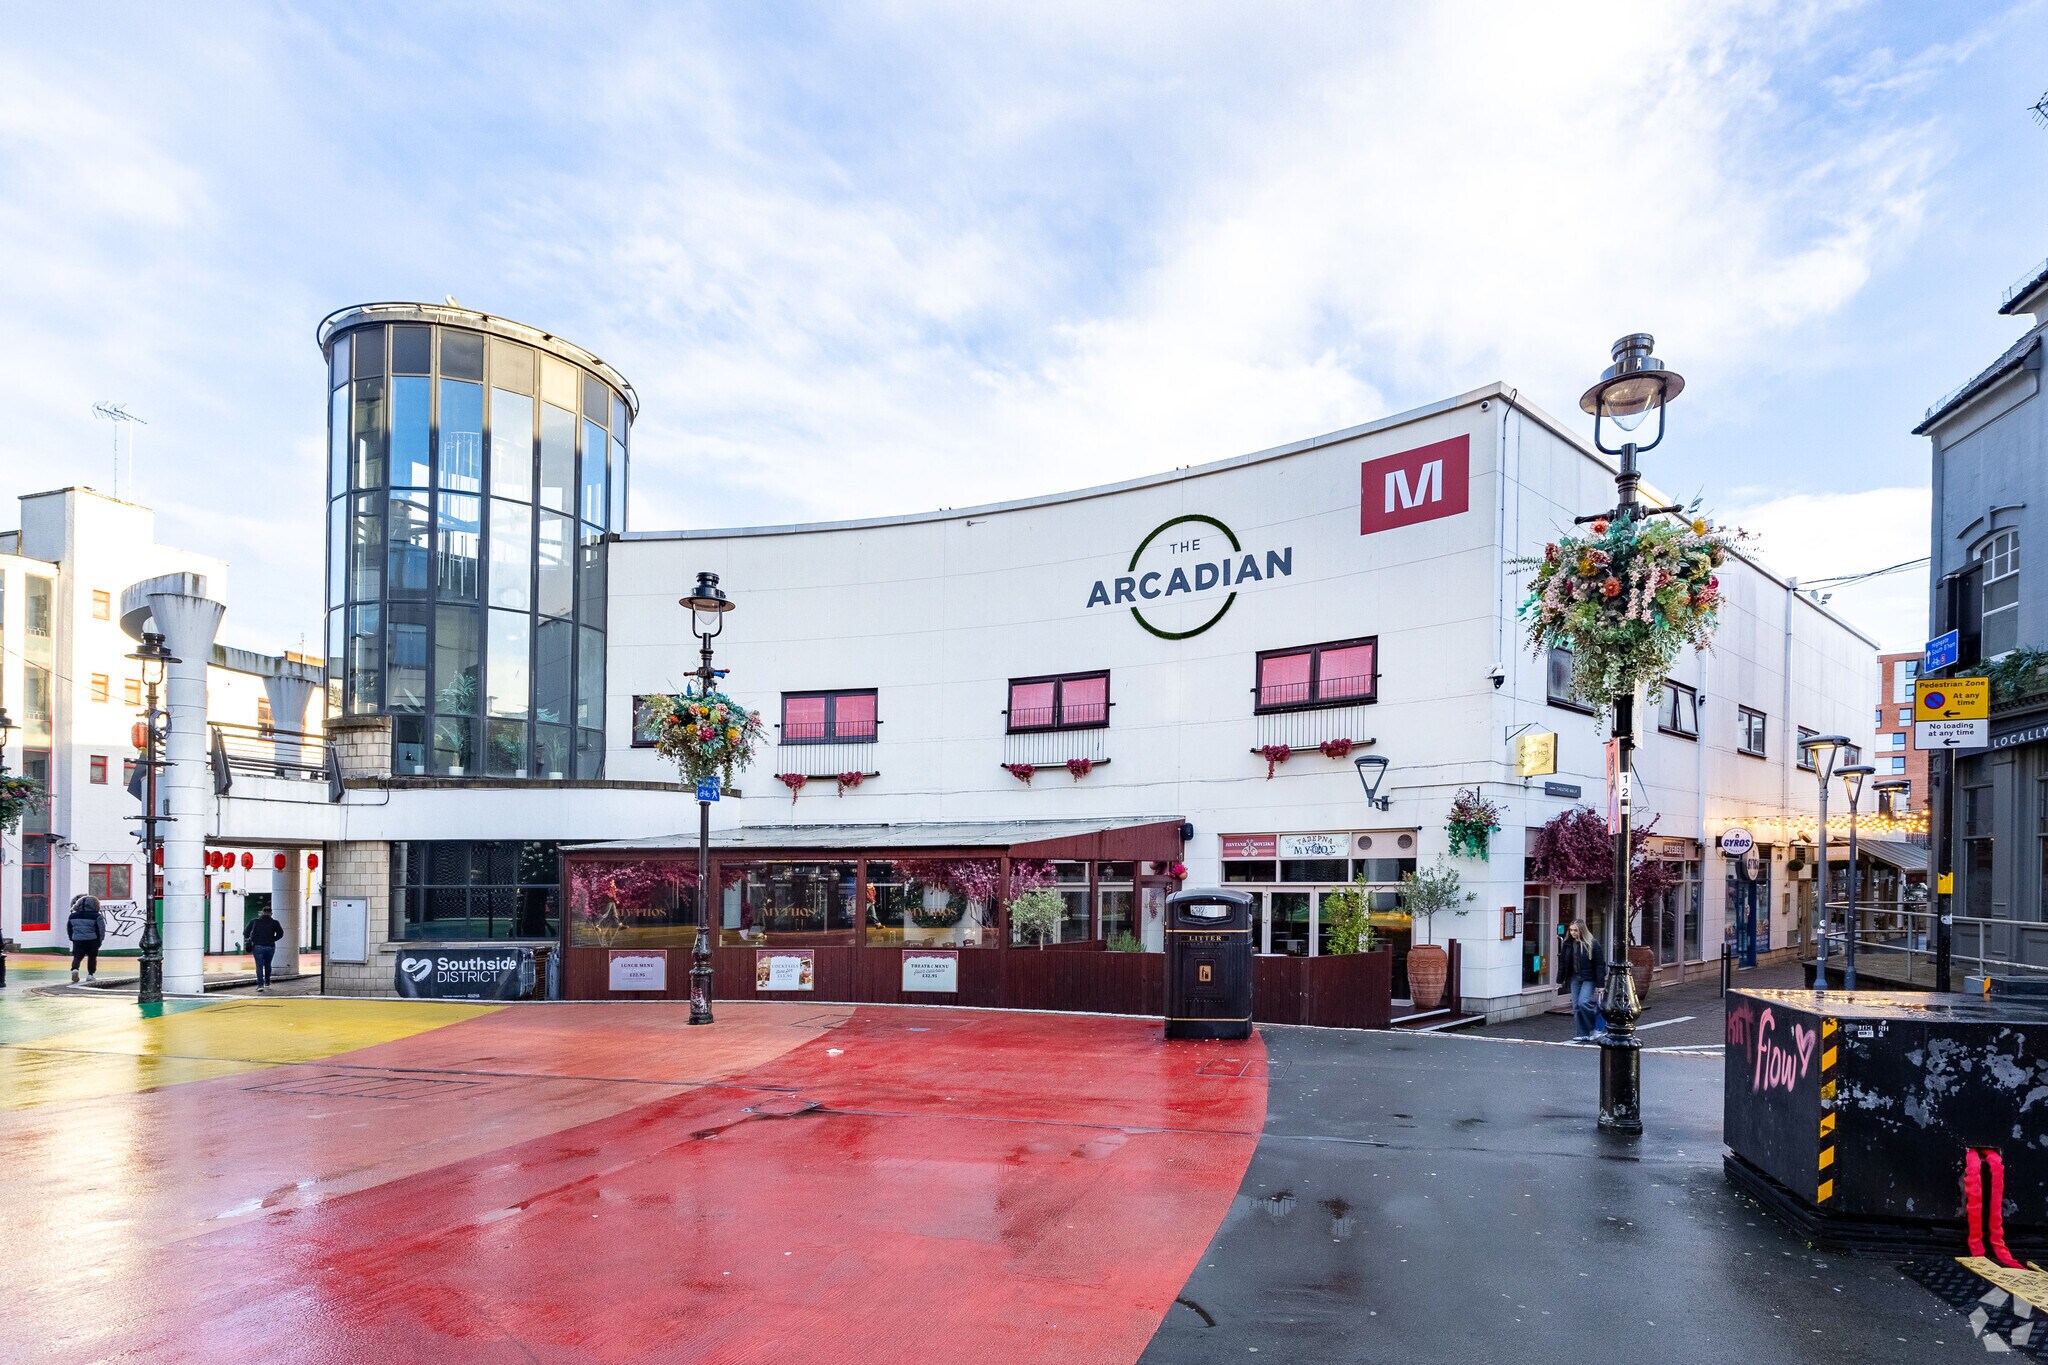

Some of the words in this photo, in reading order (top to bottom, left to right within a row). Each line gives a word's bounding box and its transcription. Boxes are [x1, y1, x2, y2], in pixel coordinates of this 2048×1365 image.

[1384, 459, 1442, 513] M
[1170, 539, 1200, 554] THE
[1086, 547, 1292, 608] ARCADIAN
[1931, 647, 1943, 656] South
[1965, 692, 1980, 700] any
[1943, 722, 1974, 730] loading
[1939, 730, 1954, 738] any
[1993, 727, 2048, 749] LOCALLY
[1622, 788, 1629, 797] 2
[1723, 838, 1751, 848] GYROS
[763, 907, 817, 917] MYTHOS
[437, 956, 517, 971] Southside
[437, 970, 500, 983] DISTRICT
